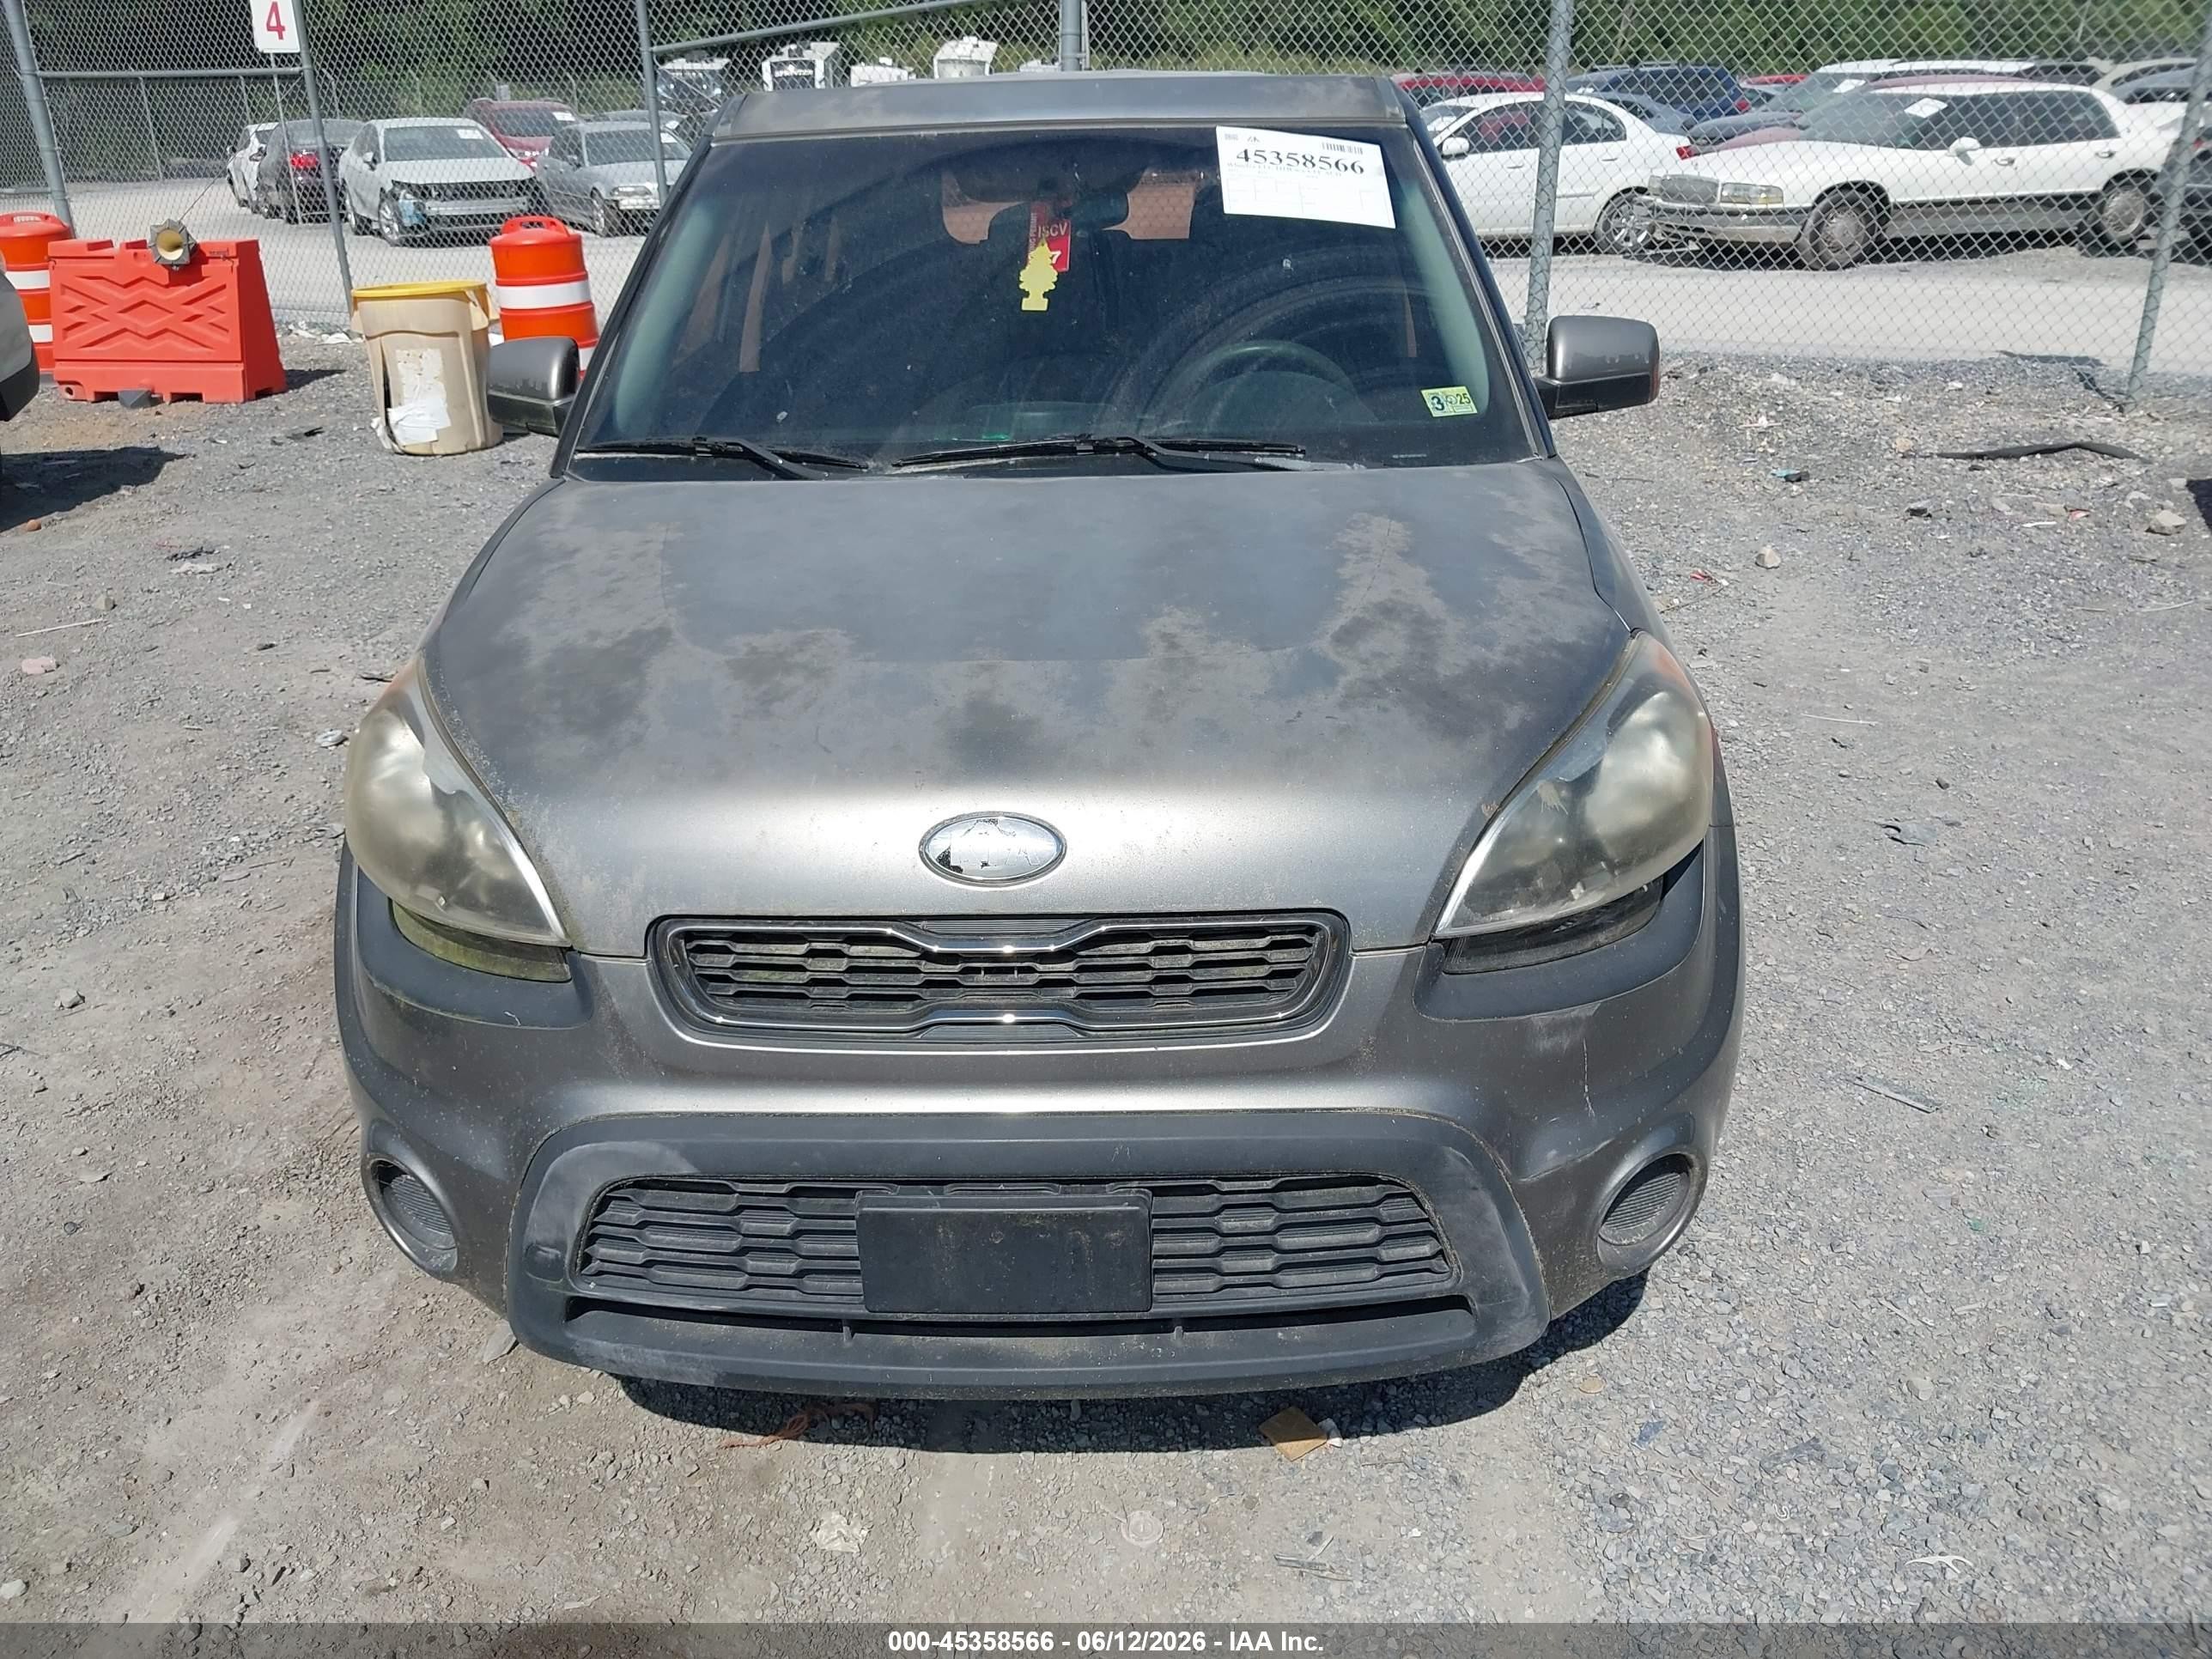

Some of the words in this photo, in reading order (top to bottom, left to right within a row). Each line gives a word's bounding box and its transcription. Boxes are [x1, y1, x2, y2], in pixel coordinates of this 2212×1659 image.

[266, 1, 286, 40] 4
[1236, 148, 1364, 175] 45358566
[1431, 395, 1445, 411] 3
[1455, 392, 1471, 405] 25
